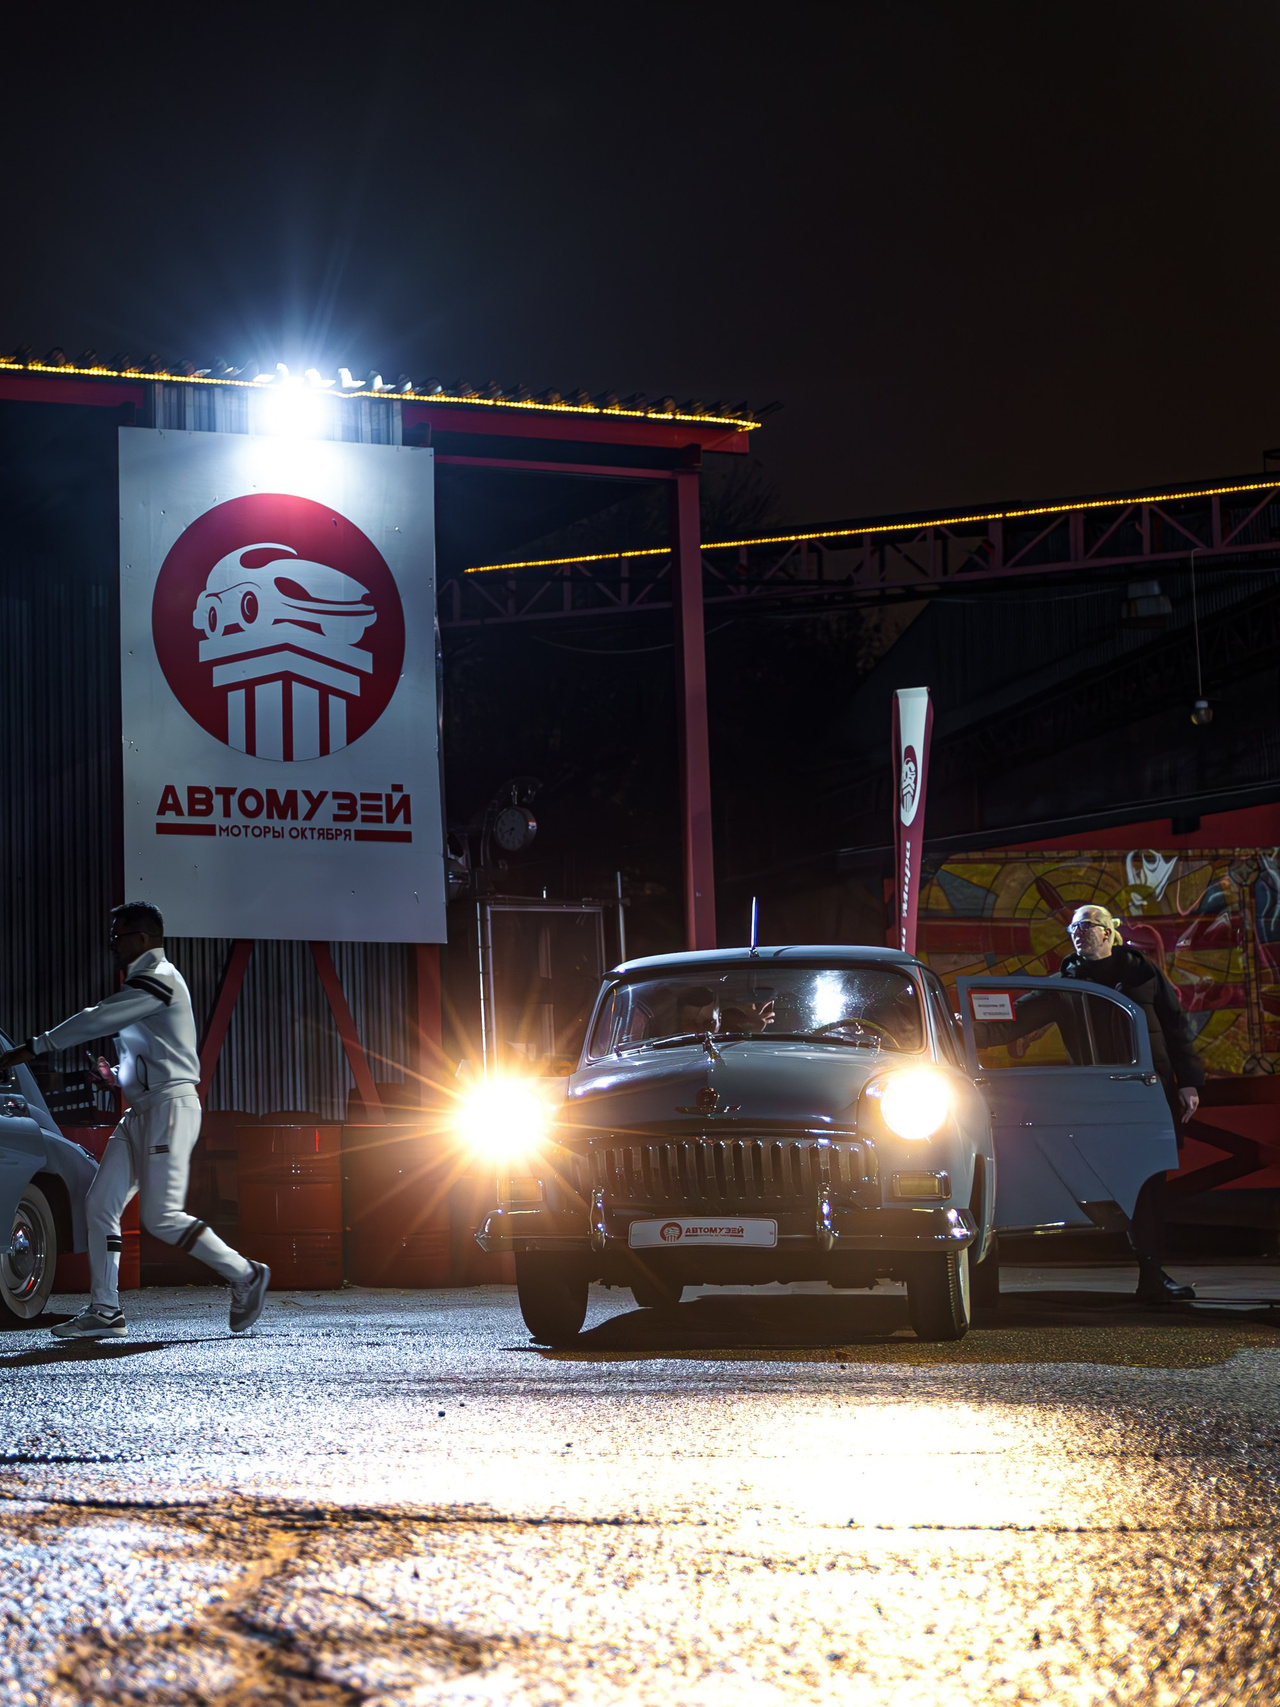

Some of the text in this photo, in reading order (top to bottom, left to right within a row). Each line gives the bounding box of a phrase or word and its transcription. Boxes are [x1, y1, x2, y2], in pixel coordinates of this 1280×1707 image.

[156, 784, 412, 825] АВТОМУЗЕЙ
[219, 824, 352, 841] МОТОРЫ ОКТЯБРЯ
[685, 1226, 744, 1234] АВТОМУЗЕЙ
